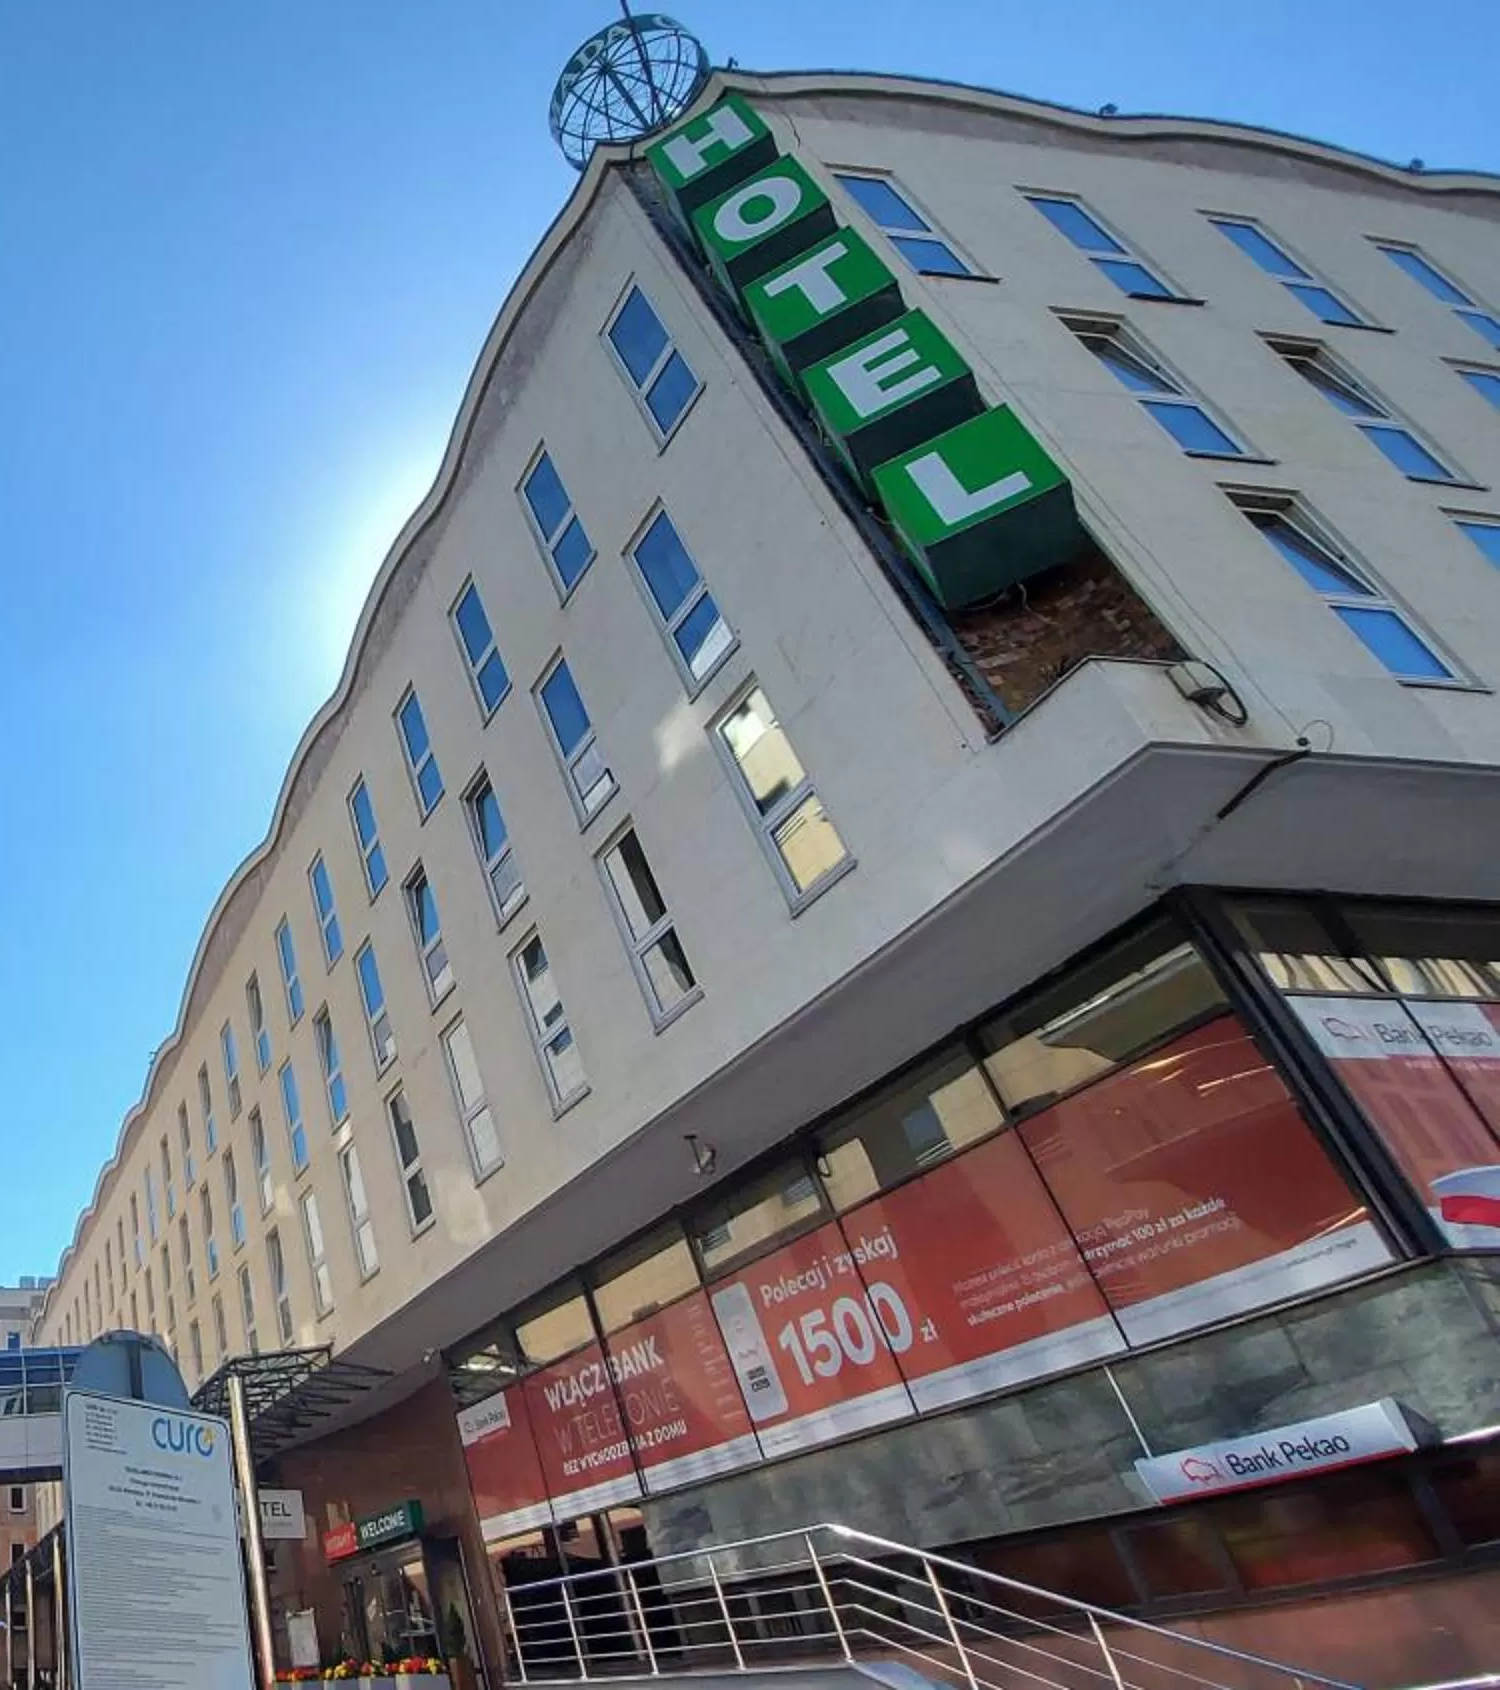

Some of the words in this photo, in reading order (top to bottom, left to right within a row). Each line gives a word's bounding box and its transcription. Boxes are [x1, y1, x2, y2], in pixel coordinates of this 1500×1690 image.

[662, 104, 1033, 526] HOTEL
[1373, 1023, 1425, 1044] Bank
[1428, 1025, 1493, 1047] Pekao
[760, 1260, 826, 1308] Polecaj
[821, 1255, 833, 1279] i
[834, 1225, 898, 1277] zyskaj
[778, 1281, 913, 1386] 1500
[920, 1318, 939, 1342] zł
[544, 1363, 605, 1412] WŁĄCZ
[604, 1336, 664, 1385] BANK
[655, 1420, 687, 1442] DOMU
[1225, 1447, 1286, 1476] Bank
[1278, 1435, 1350, 1464] Pekao
[360, 1509, 405, 1541] WELCOME
